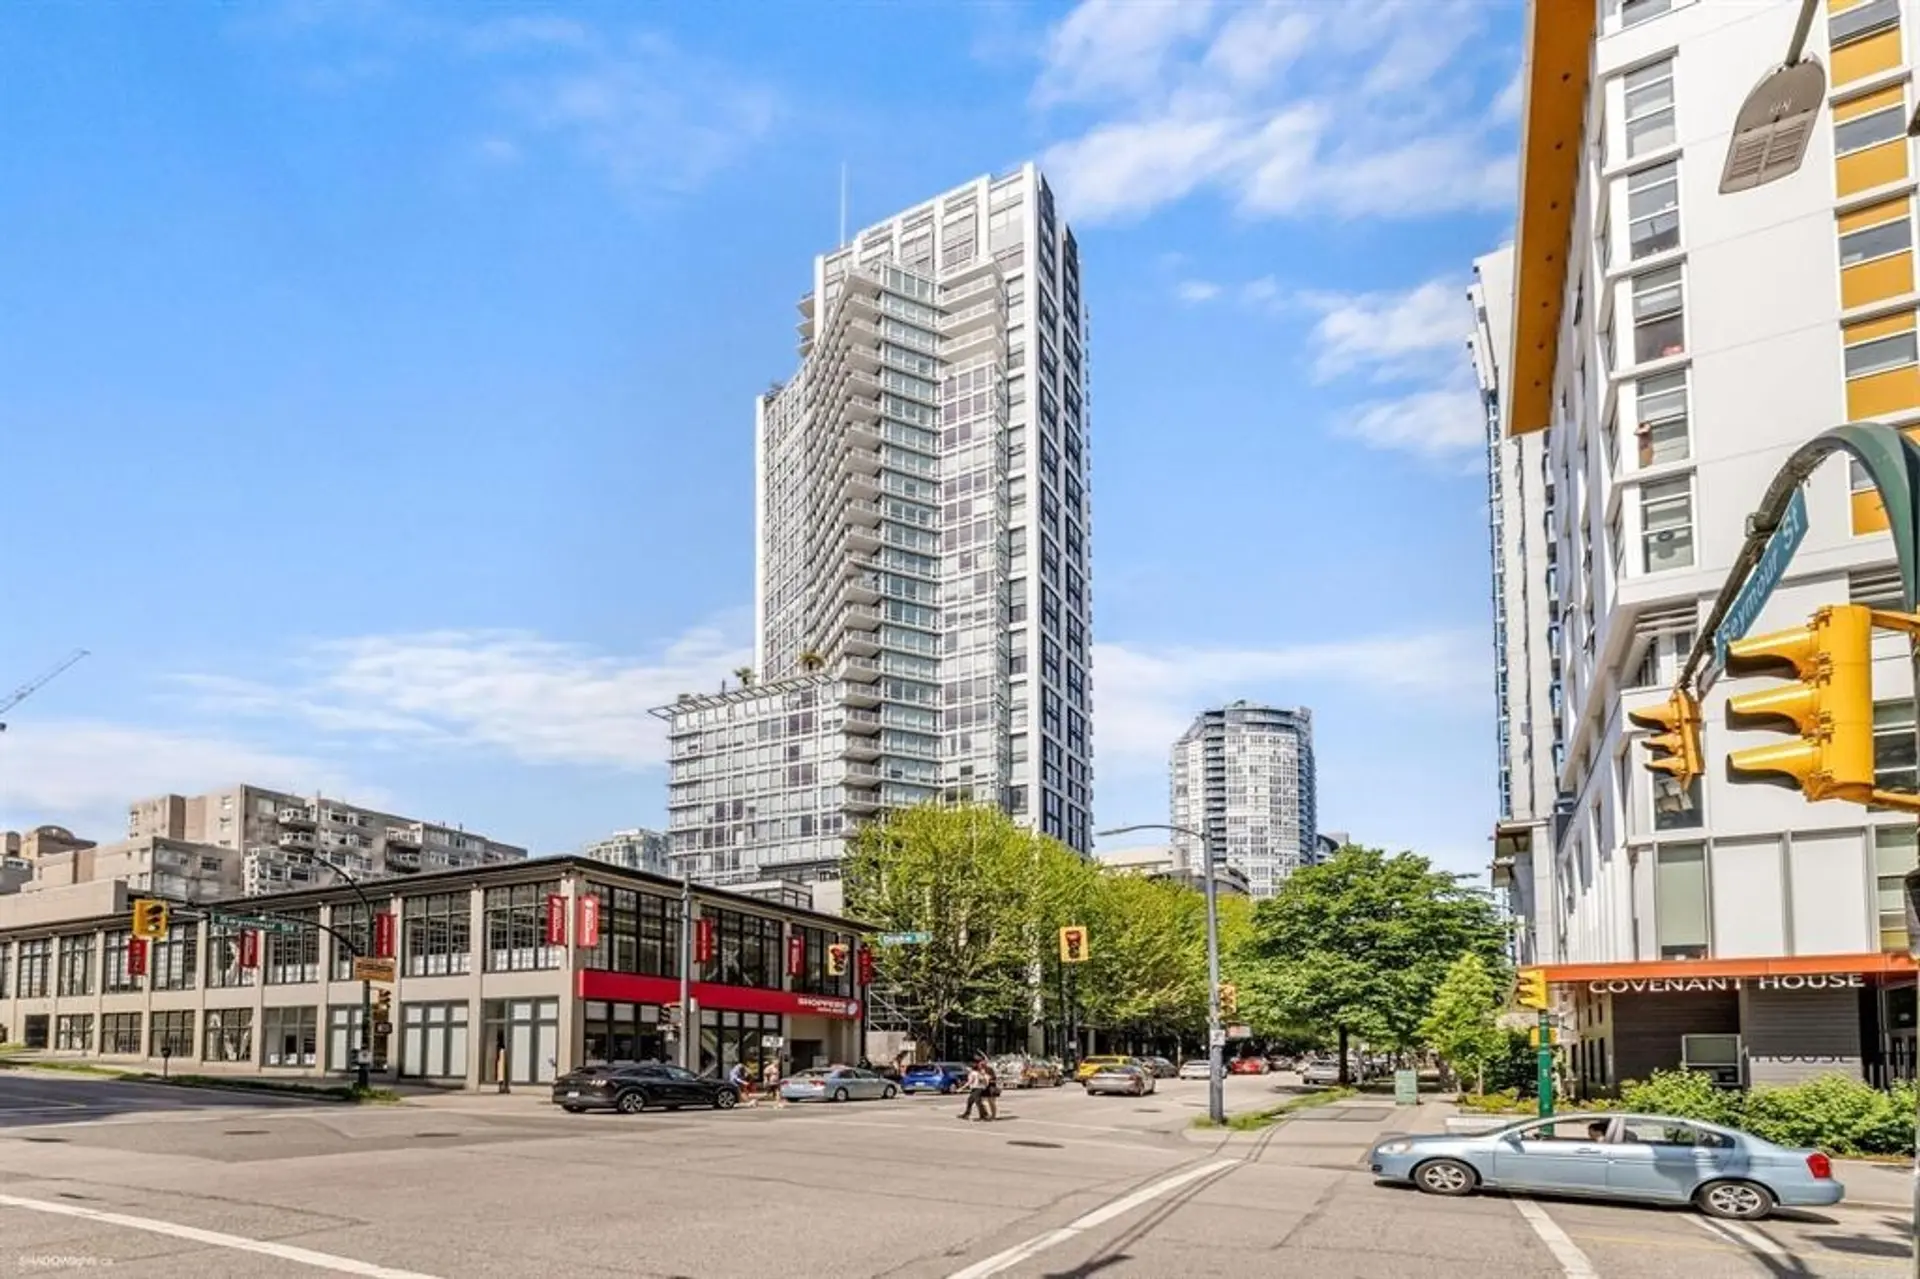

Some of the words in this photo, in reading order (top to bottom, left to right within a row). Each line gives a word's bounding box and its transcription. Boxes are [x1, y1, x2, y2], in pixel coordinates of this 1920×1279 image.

[1720, 548, 1779, 642] Seymour
[1782, 505, 1801, 551] St
[1588, 978, 1742, 993] COVENANT
[1759, 973, 1867, 990] HOUSE
